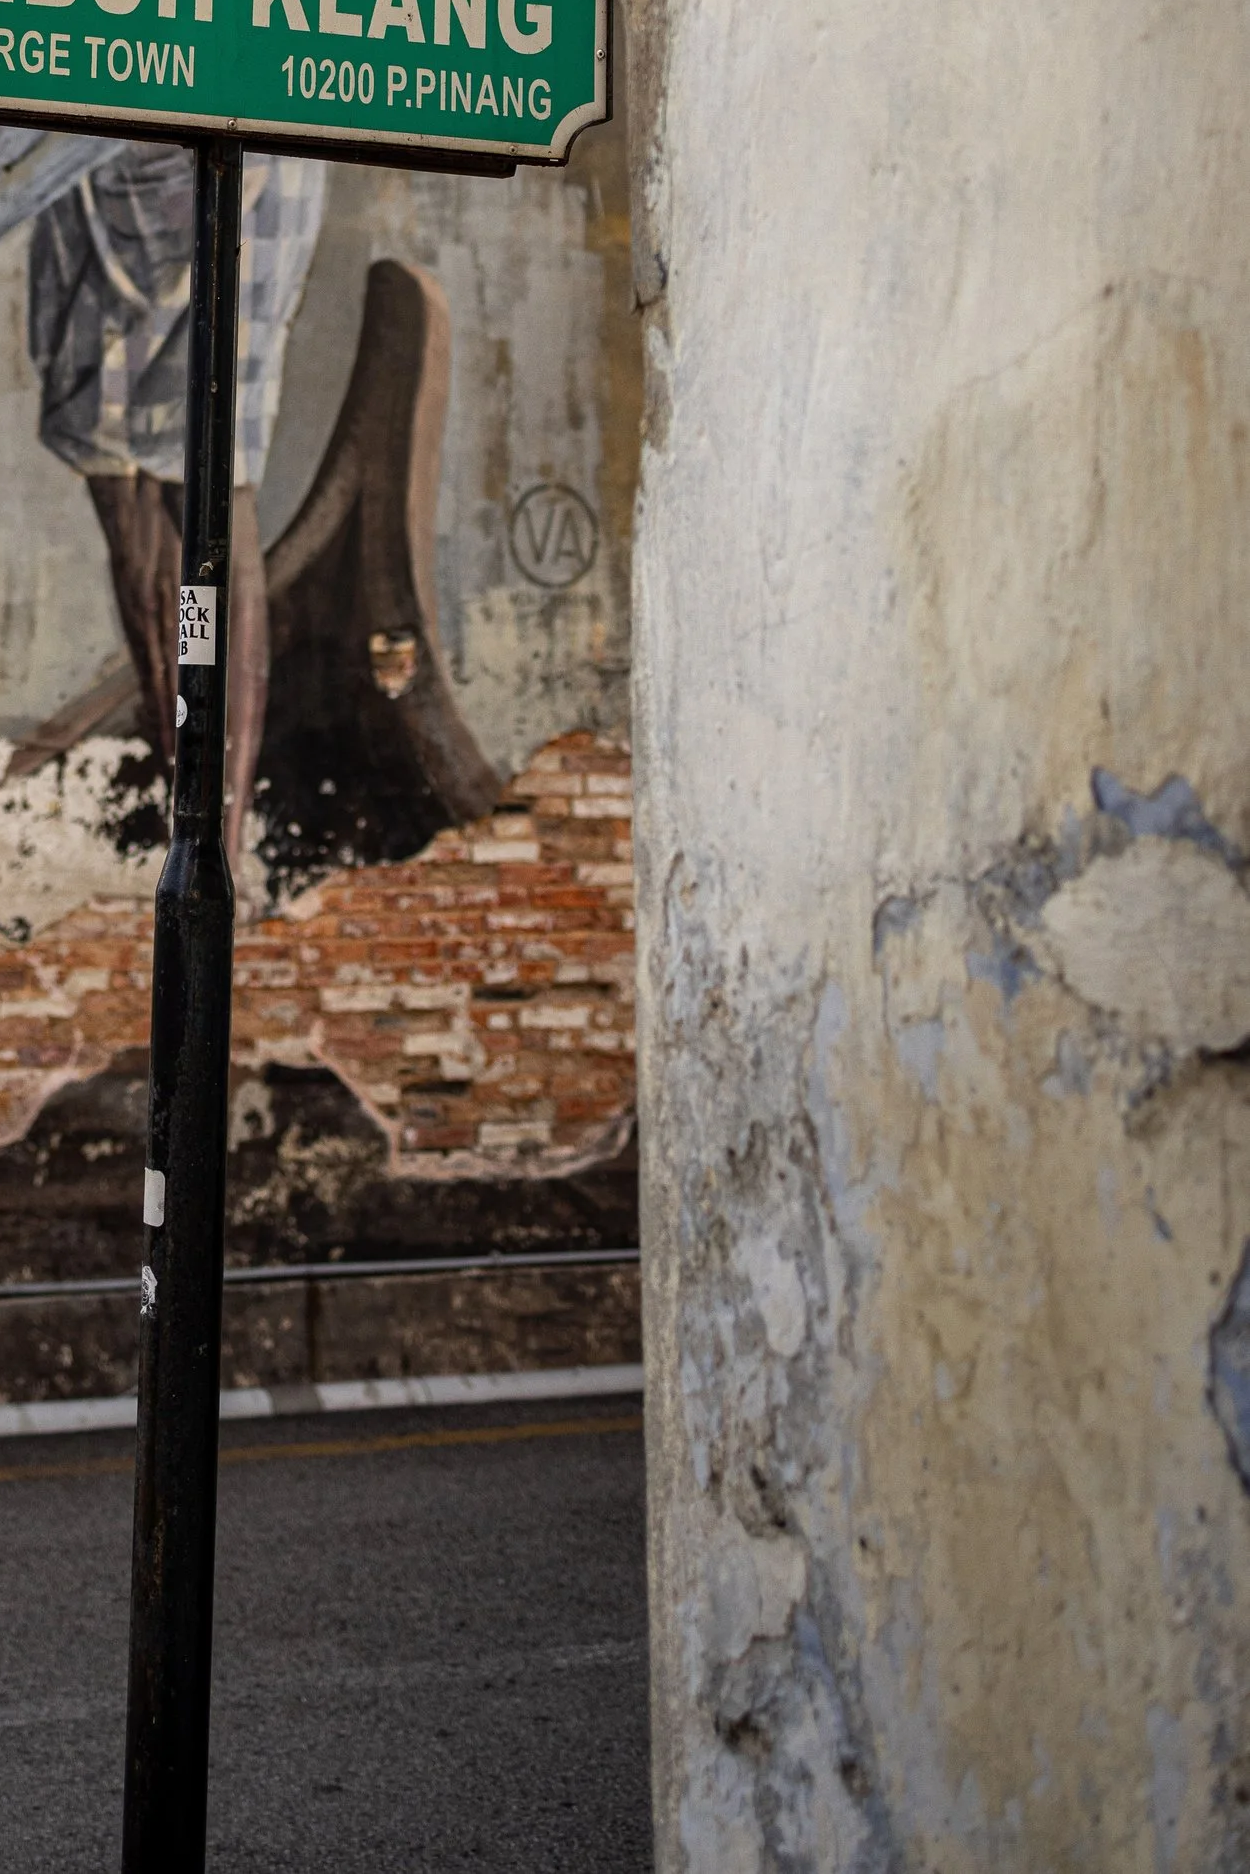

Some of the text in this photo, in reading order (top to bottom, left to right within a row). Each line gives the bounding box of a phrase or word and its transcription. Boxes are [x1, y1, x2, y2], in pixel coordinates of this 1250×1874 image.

[84, 36, 196, 89] TOWN
[282, 55, 552, 121] 10200 P.PINANG
[521, 505, 587, 567] VA
